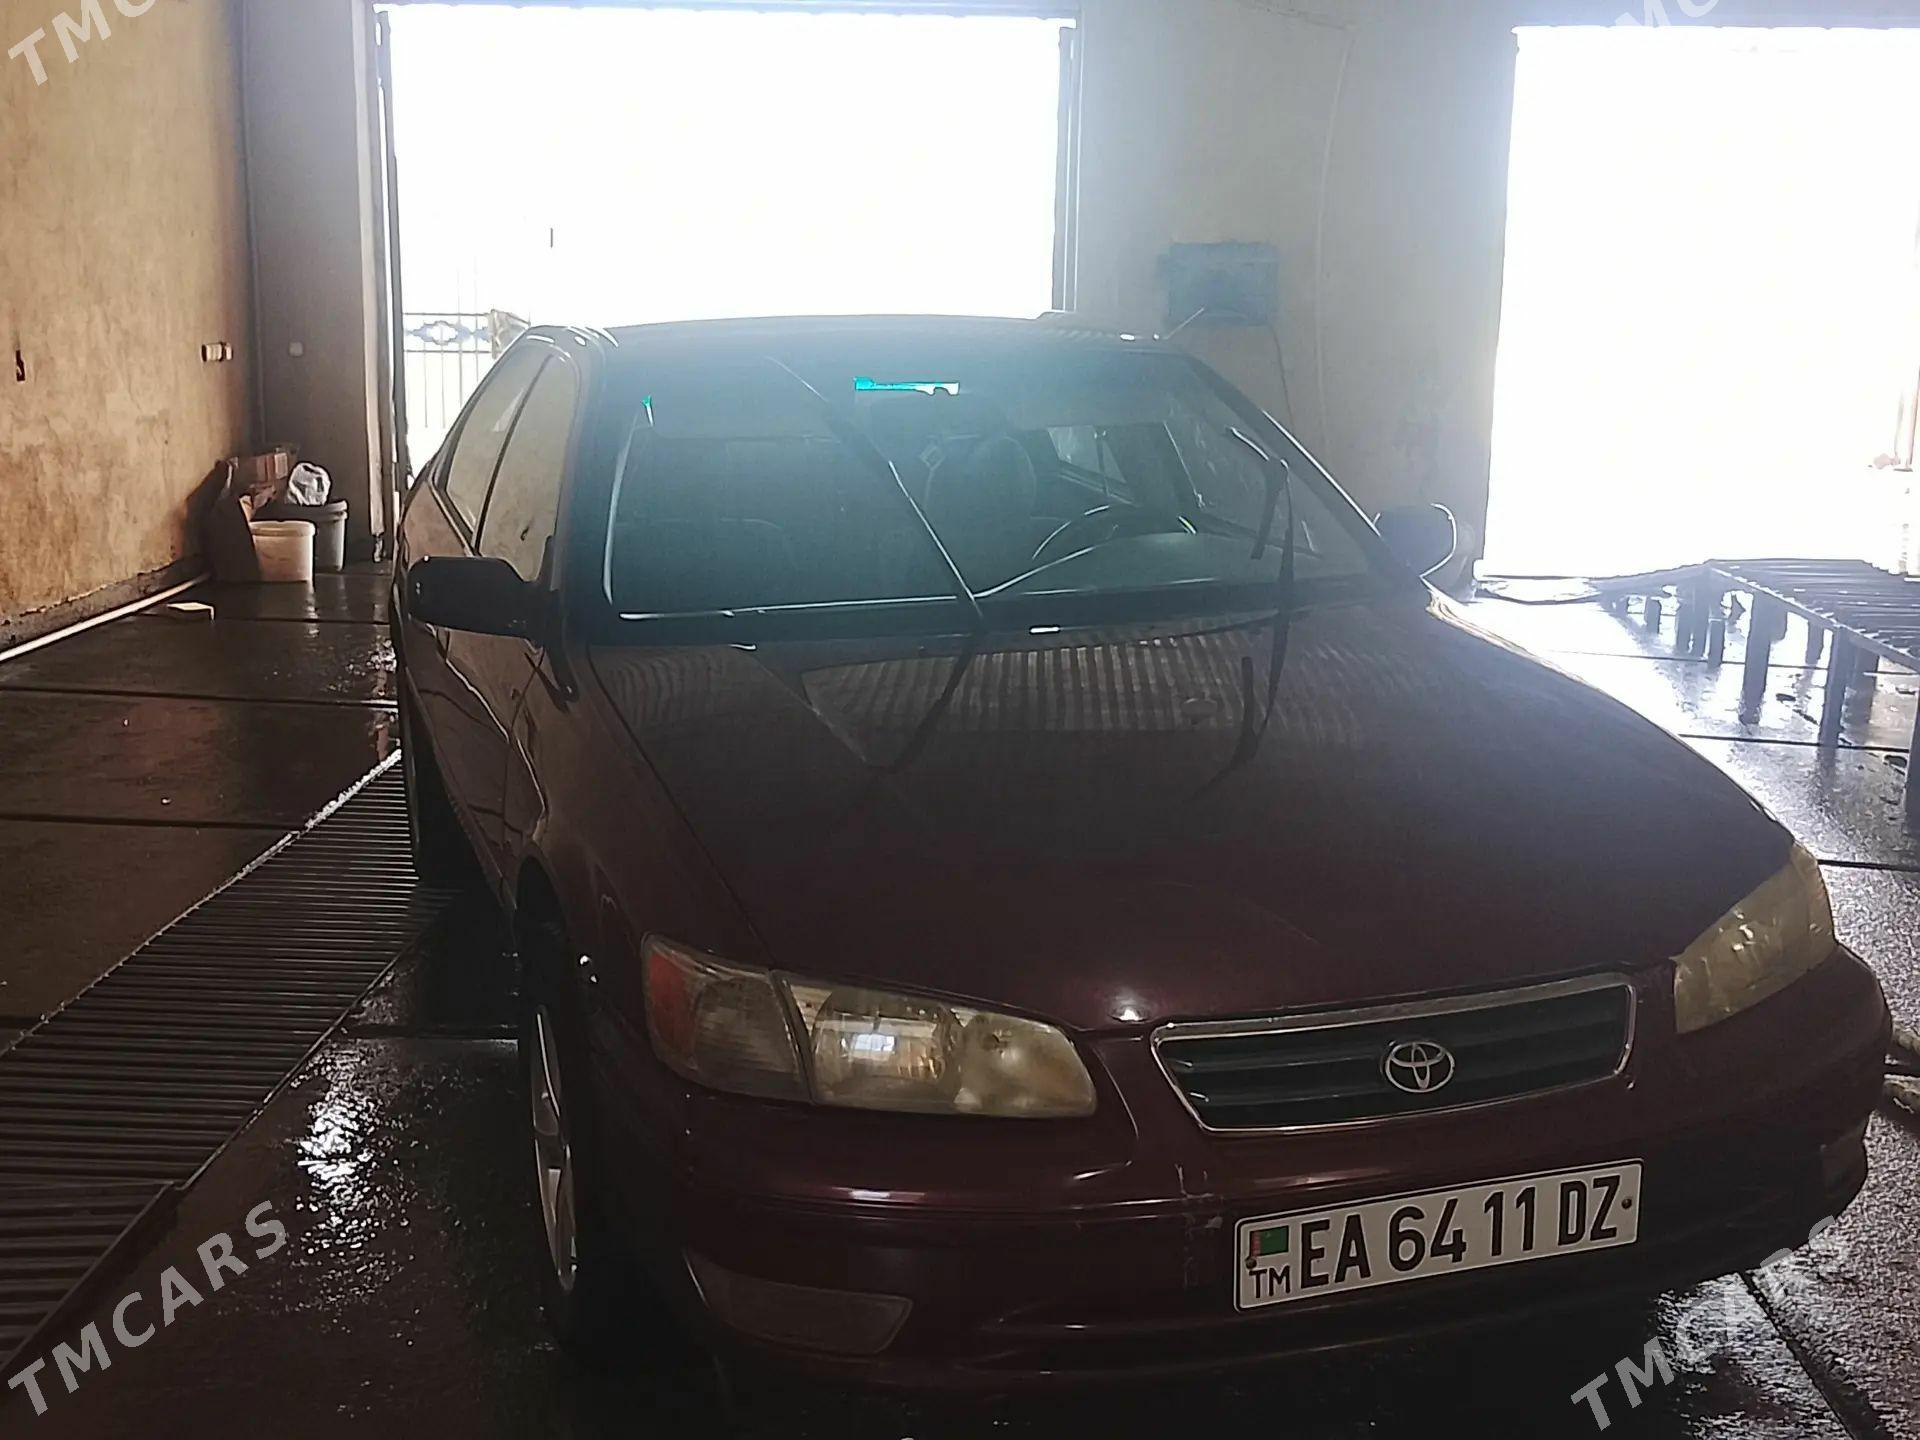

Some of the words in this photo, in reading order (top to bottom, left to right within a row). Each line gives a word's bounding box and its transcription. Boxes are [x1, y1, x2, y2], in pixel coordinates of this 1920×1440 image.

[1300, 1213, 1371, 1289] EA
[1557, 1175, 1621, 1246] DZ
[1249, 1265, 1291, 1299] TM
